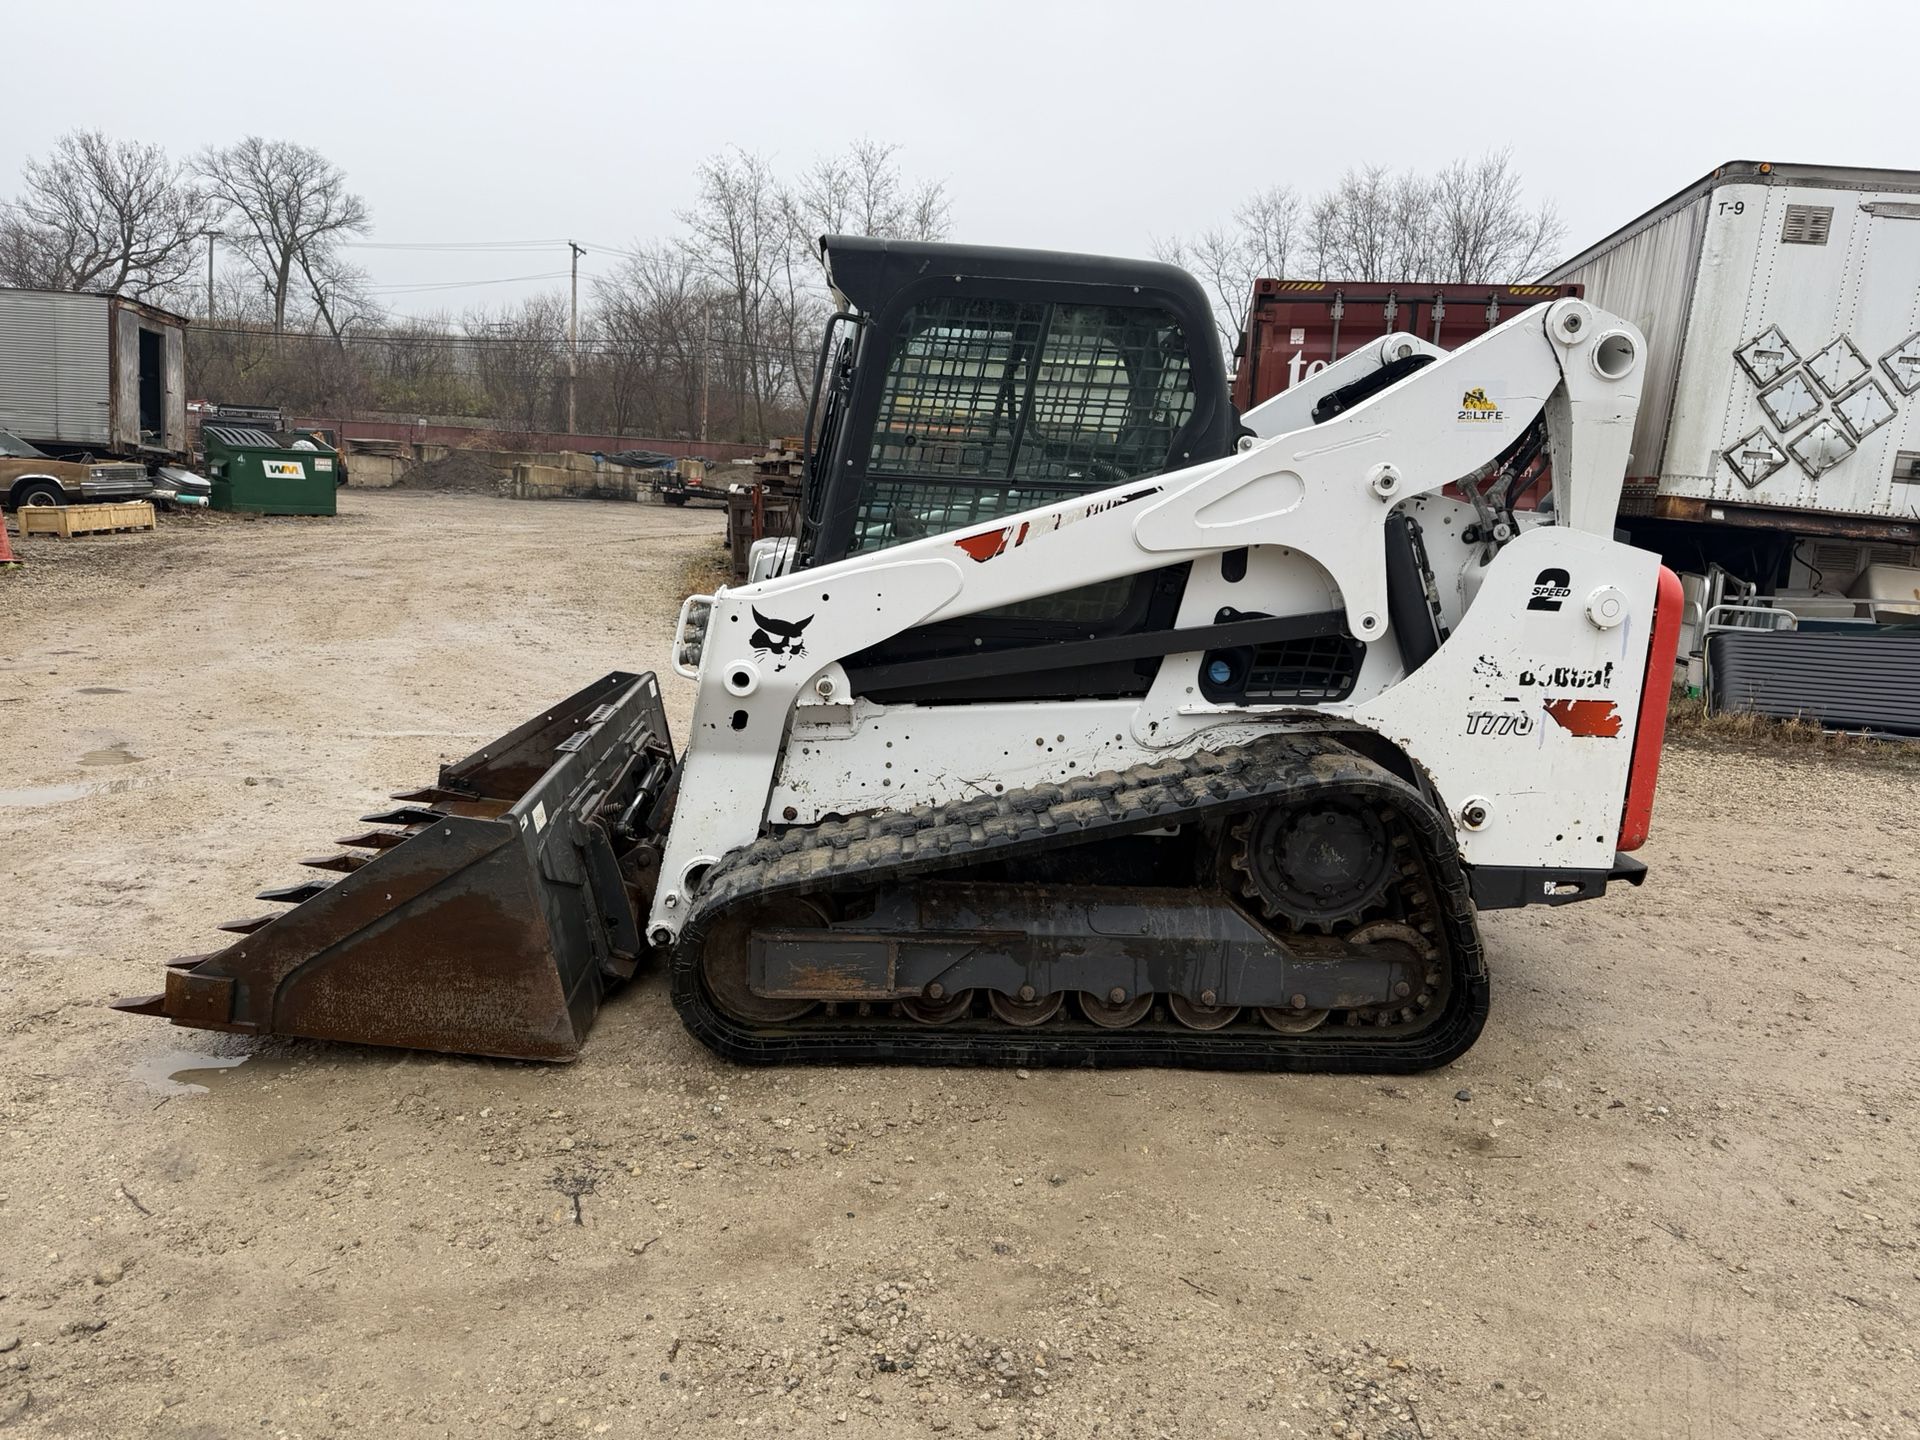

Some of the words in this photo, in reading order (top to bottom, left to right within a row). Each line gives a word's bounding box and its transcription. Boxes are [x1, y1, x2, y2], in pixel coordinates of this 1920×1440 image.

[1718, 201, 1745, 216] T-9
[269, 464, 300, 475] WM
[1526, 567, 1571, 612] 2
[1531, 586, 1571, 598] SPEED
